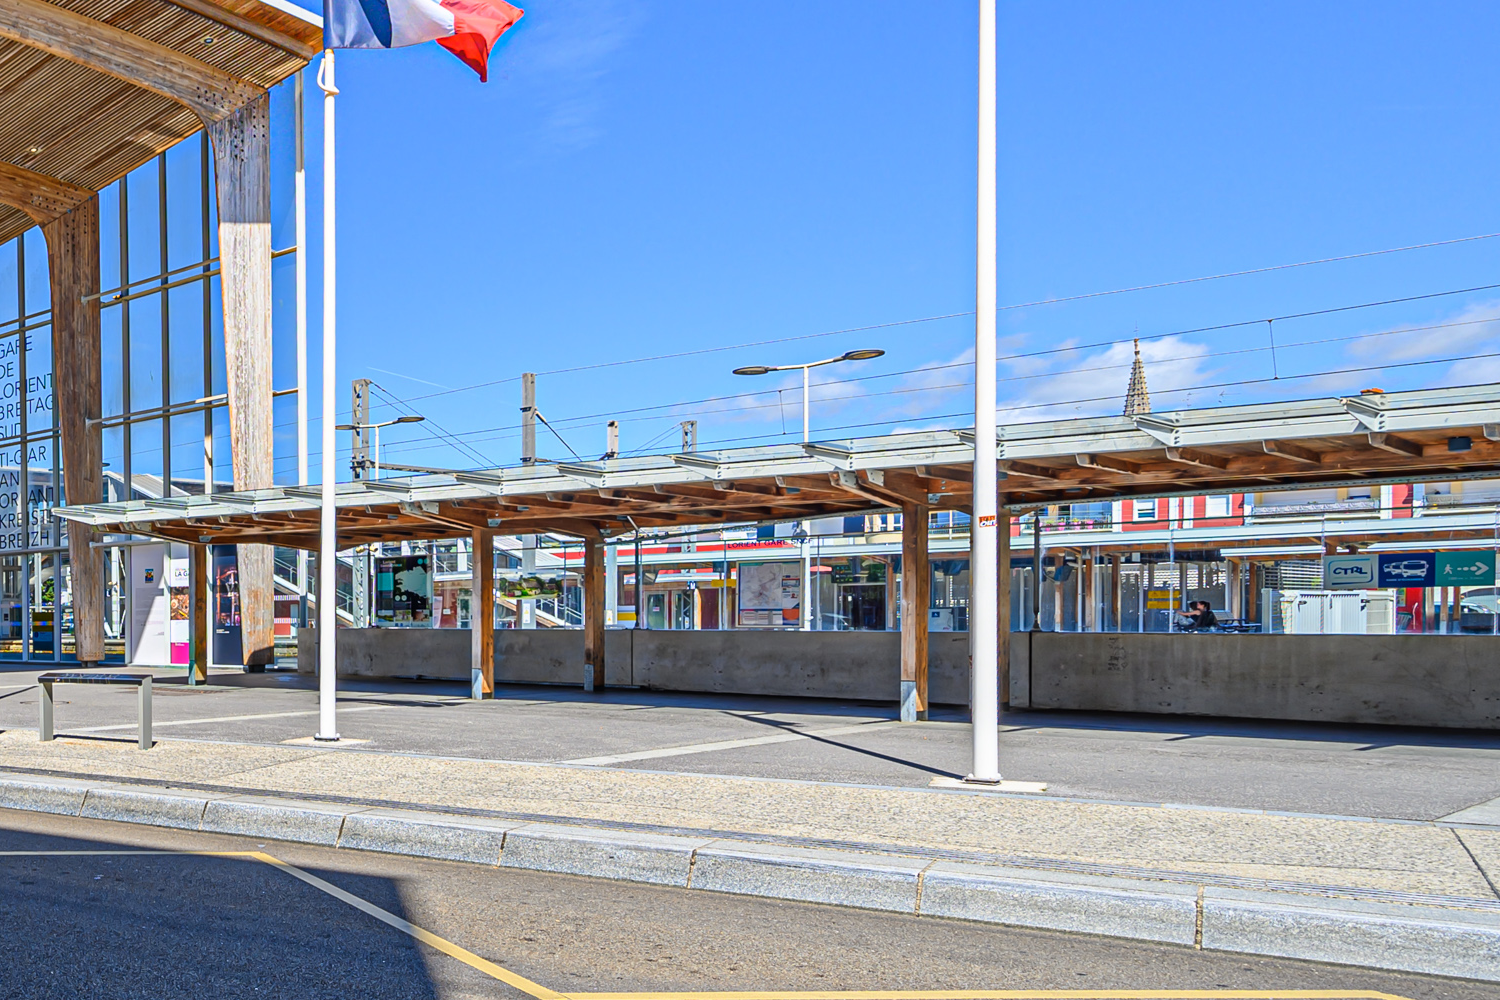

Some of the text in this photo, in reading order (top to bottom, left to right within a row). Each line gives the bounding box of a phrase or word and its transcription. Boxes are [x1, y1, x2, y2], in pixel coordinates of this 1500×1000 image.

[0, 471, 20, 488] AN
[0, 487, 54, 509] ORANT
[0, 530, 49, 549] BREIZH
[727, 537, 813, 549] LORIENT GARE SNCF
[1333, 565, 1368, 576] CTRL
